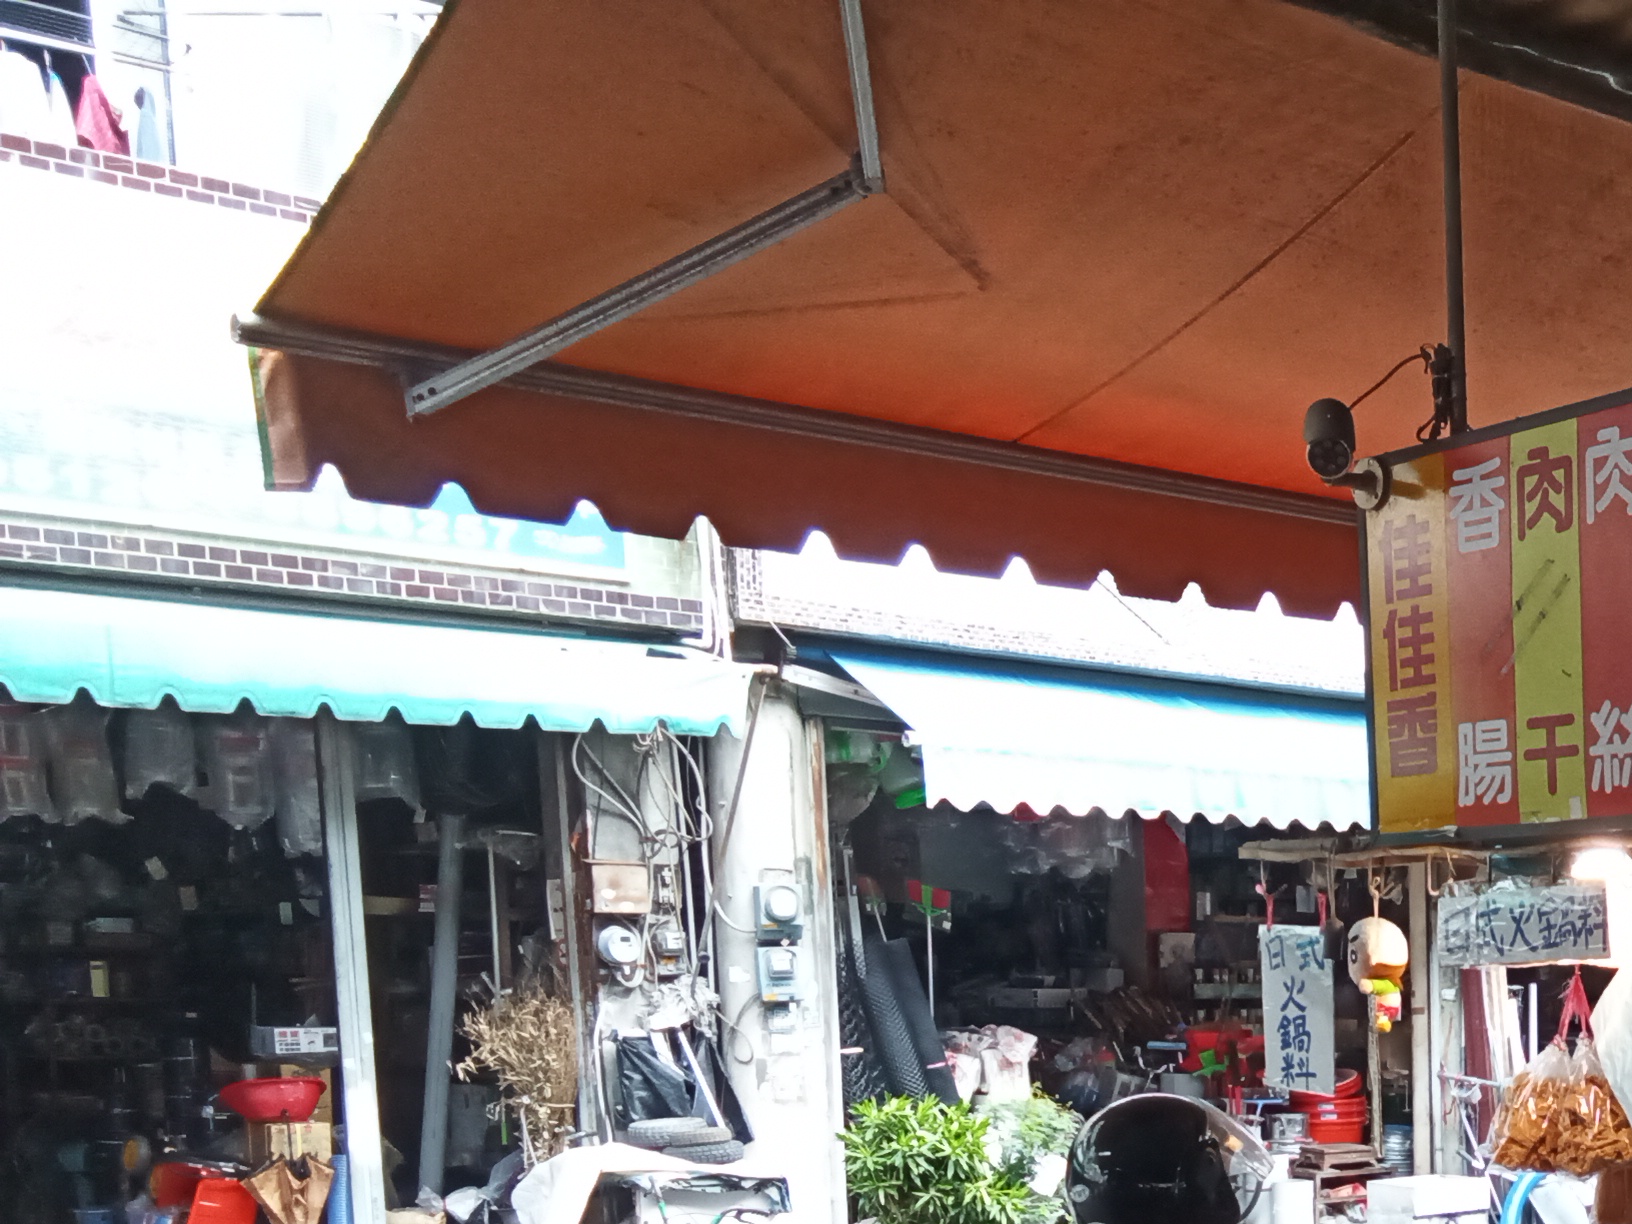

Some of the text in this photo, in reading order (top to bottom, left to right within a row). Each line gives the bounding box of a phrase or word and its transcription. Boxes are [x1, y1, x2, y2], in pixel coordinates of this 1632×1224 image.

[1377, 513, 1439, 779] 佳佳香
[1448, 456, 1513, 807] 香腸
[1515, 445, 1580, 796] 肉干
